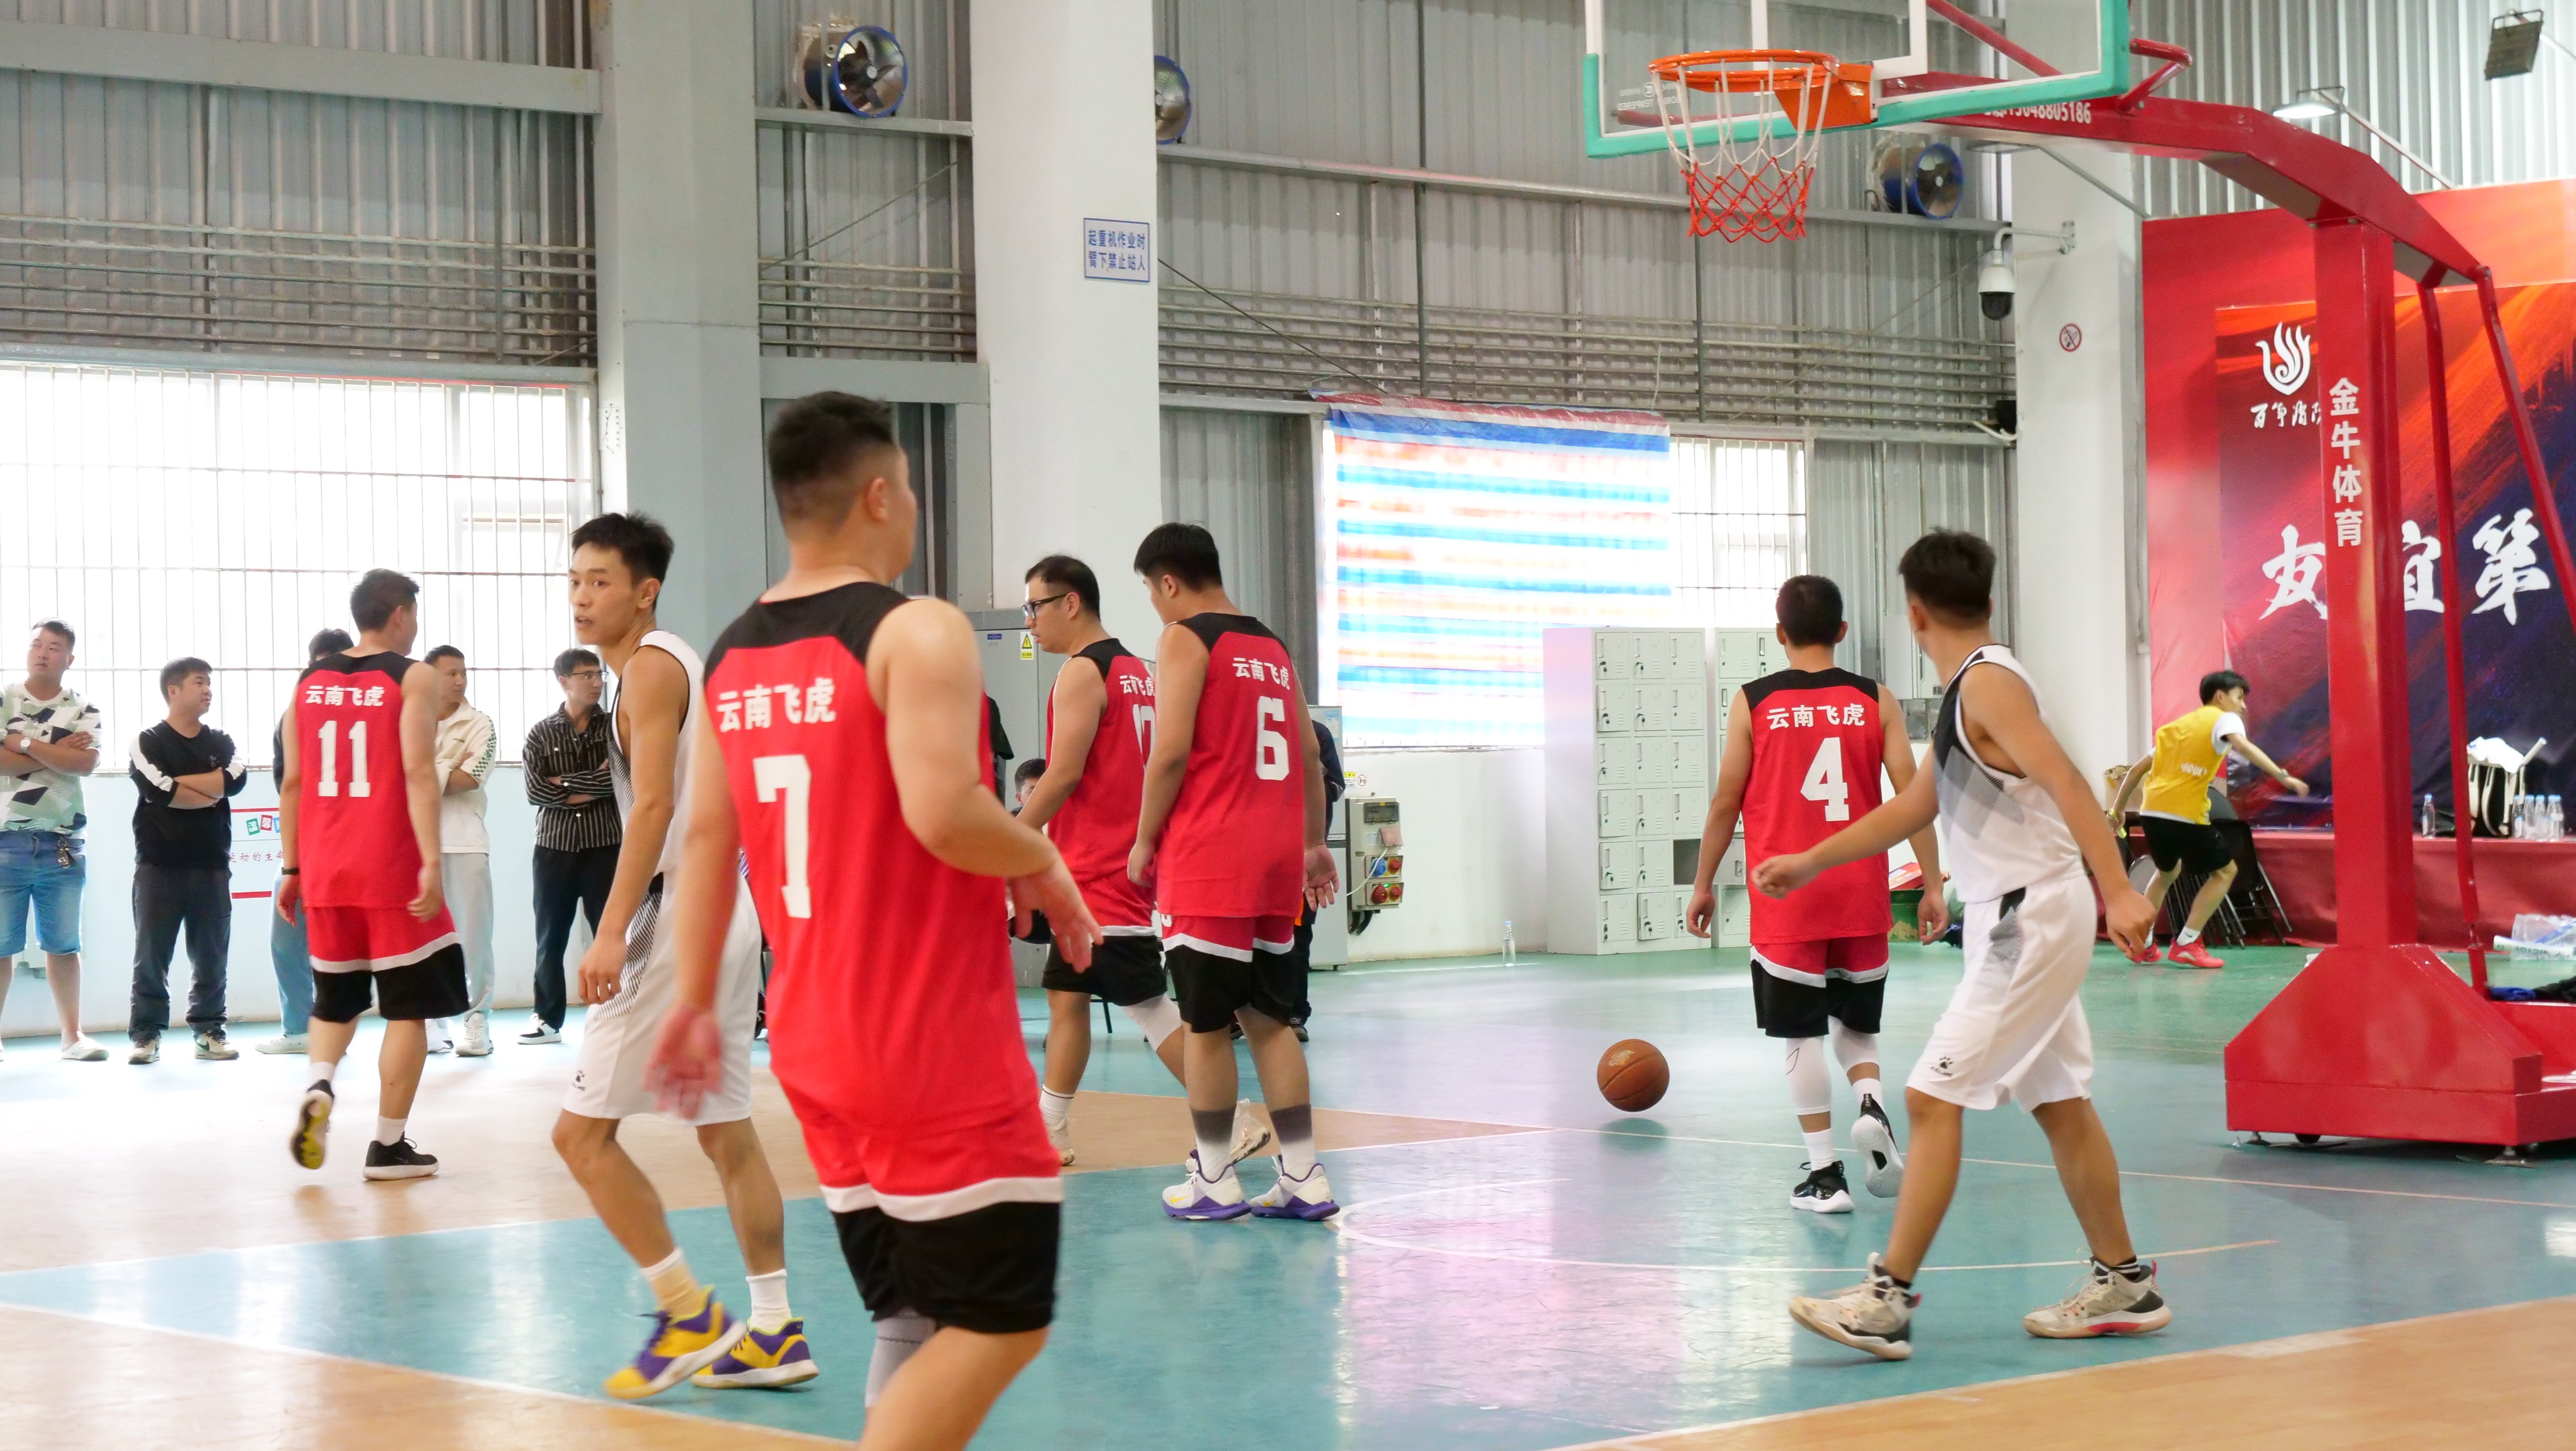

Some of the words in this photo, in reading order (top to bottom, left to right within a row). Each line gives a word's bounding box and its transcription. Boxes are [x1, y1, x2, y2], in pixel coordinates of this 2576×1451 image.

[1088, 229, 1145, 249] 起重机作业时
[2329, 378, 2363, 547] 金牛体育
[306, 685, 385, 707] 云南飞虎
[717, 677, 837, 732] 云南飞虎
[1232, 657, 1290, 690] 云南飞虎
[1256, 696, 1290, 781] 6
[1766, 703, 1865, 730] 云南飞虎
[318, 720, 371, 798] 11
[1800, 737, 1850, 821] 4
[753, 754, 812, 919] 7
